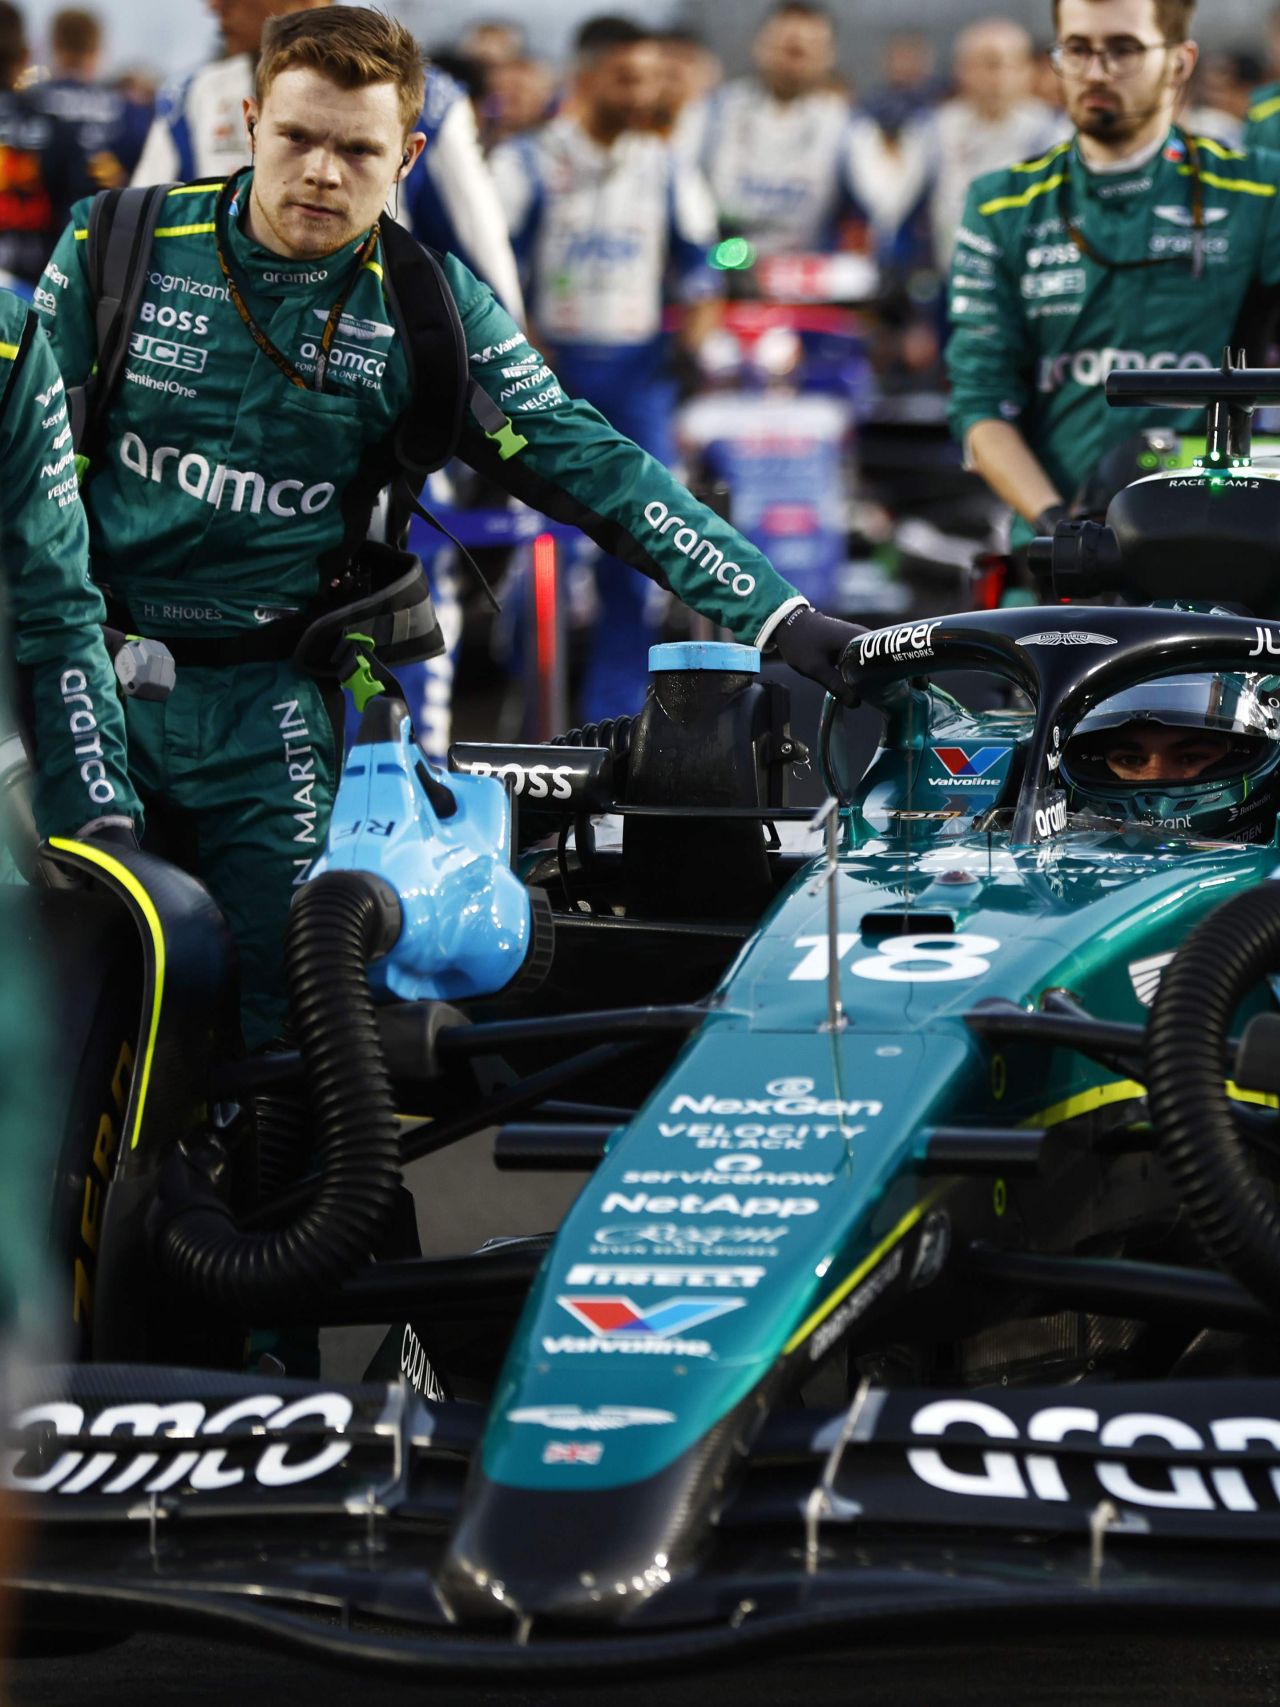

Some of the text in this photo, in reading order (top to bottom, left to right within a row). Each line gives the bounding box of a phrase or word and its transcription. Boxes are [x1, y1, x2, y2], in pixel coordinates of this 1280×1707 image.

[146, 271, 232, 302] ognizant
[263, 270, 328, 284] aramco
[140, 302, 209, 335] BOSS
[125, 367, 197, 398] SentinelOne
[120, 431, 335, 517] aramco
[1169, 478, 1260, 489] RACE TEAM 2
[644, 501, 756, 597] aramco
[163, 606, 223, 621] RHODES
[893, 648, 935, 663] NETWORKS
[60, 669, 116, 804] aramco
[272, 699, 316, 844] MARTIN
[928, 777, 1000, 787] Valvoline
[787, 932, 1001, 983] 18
[669, 1094, 884, 1117] NexGen
[657, 1122, 867, 1140] VELOCITY
[696, 1138, 807, 1151] BLACK
[621, 1170, 836, 1187] servicenow
[600, 1192, 820, 1219] NetApp
[564, 1263, 767, 1288] PIRELLI
[541, 1335, 713, 1356] Valvoline
[6, 1392, 354, 1494] amco
